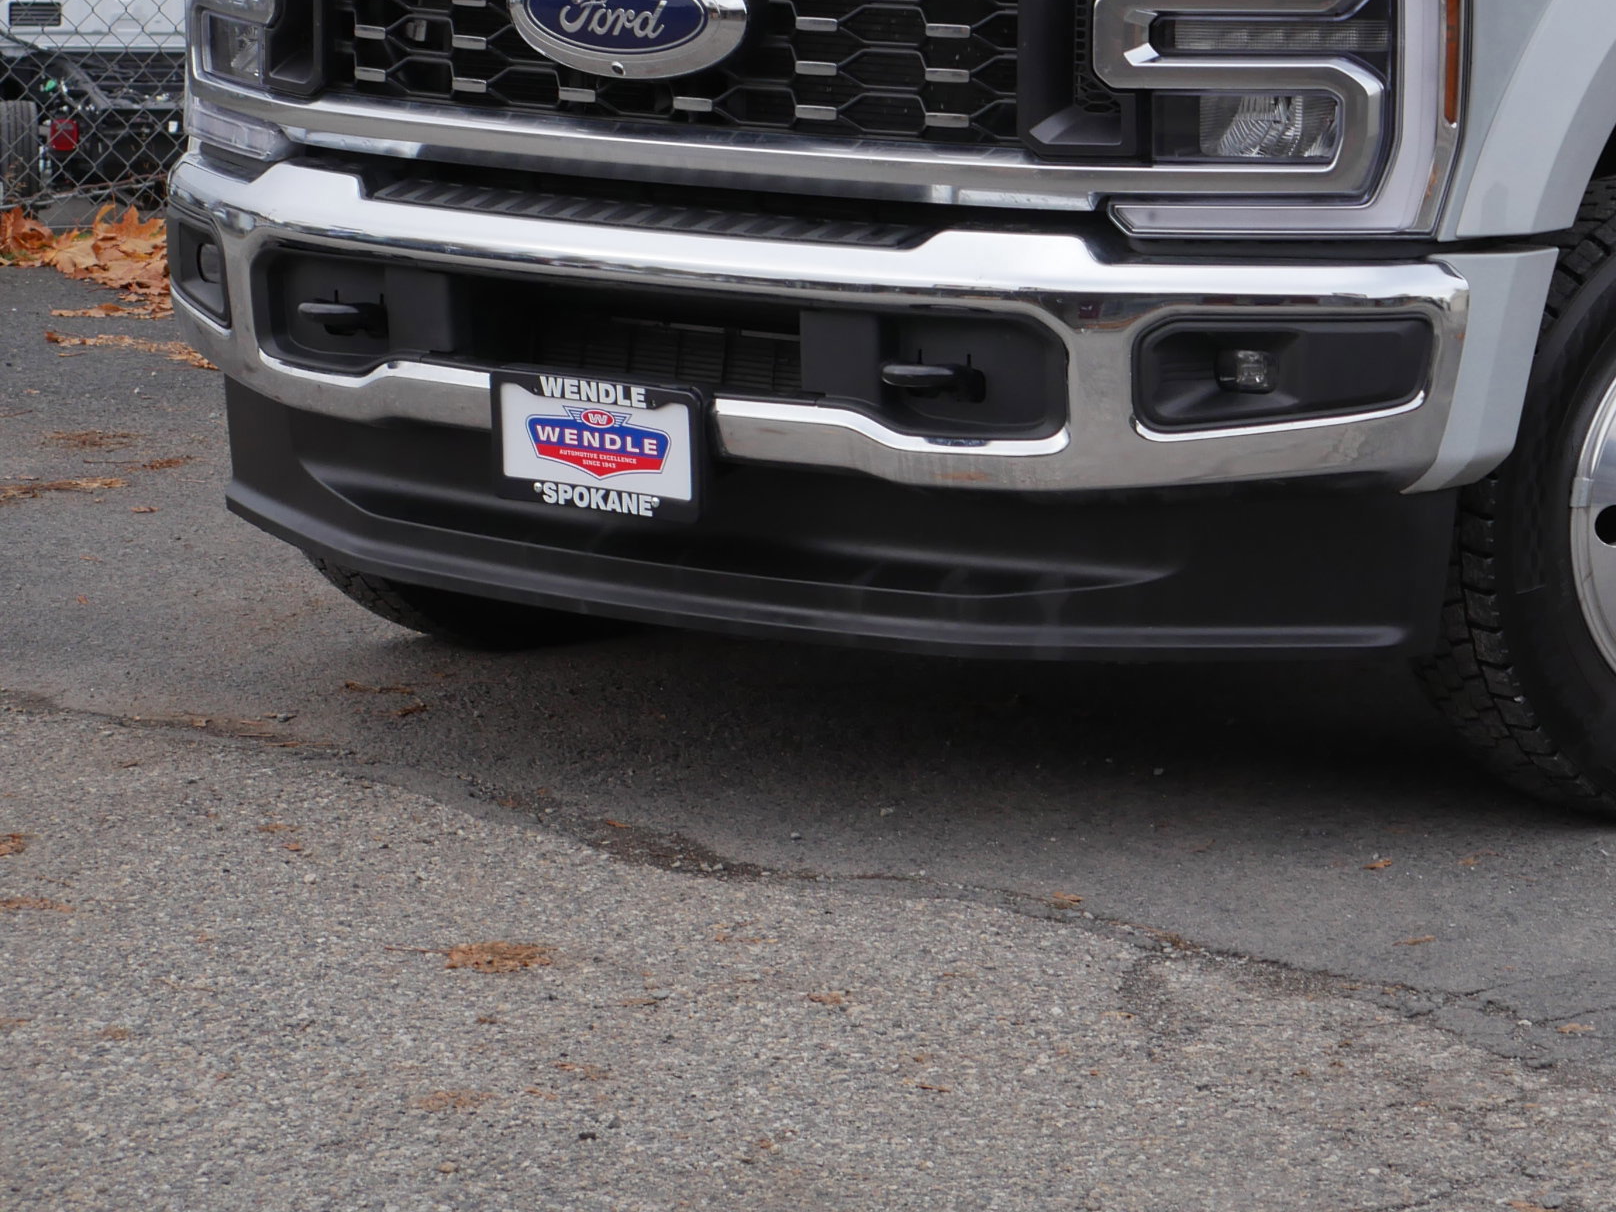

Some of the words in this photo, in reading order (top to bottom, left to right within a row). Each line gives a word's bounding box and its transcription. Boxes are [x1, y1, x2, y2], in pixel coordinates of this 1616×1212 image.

[539, 375, 647, 409] WENDLE
[536, 425, 658, 455] WENDLE
[559, 449, 598, 459] AUTOMOTIVE
[599, 453, 637, 464] EXCELLENCE
[582, 459, 601, 467] SINCE
[542, 482, 653, 517] SPOKANE
